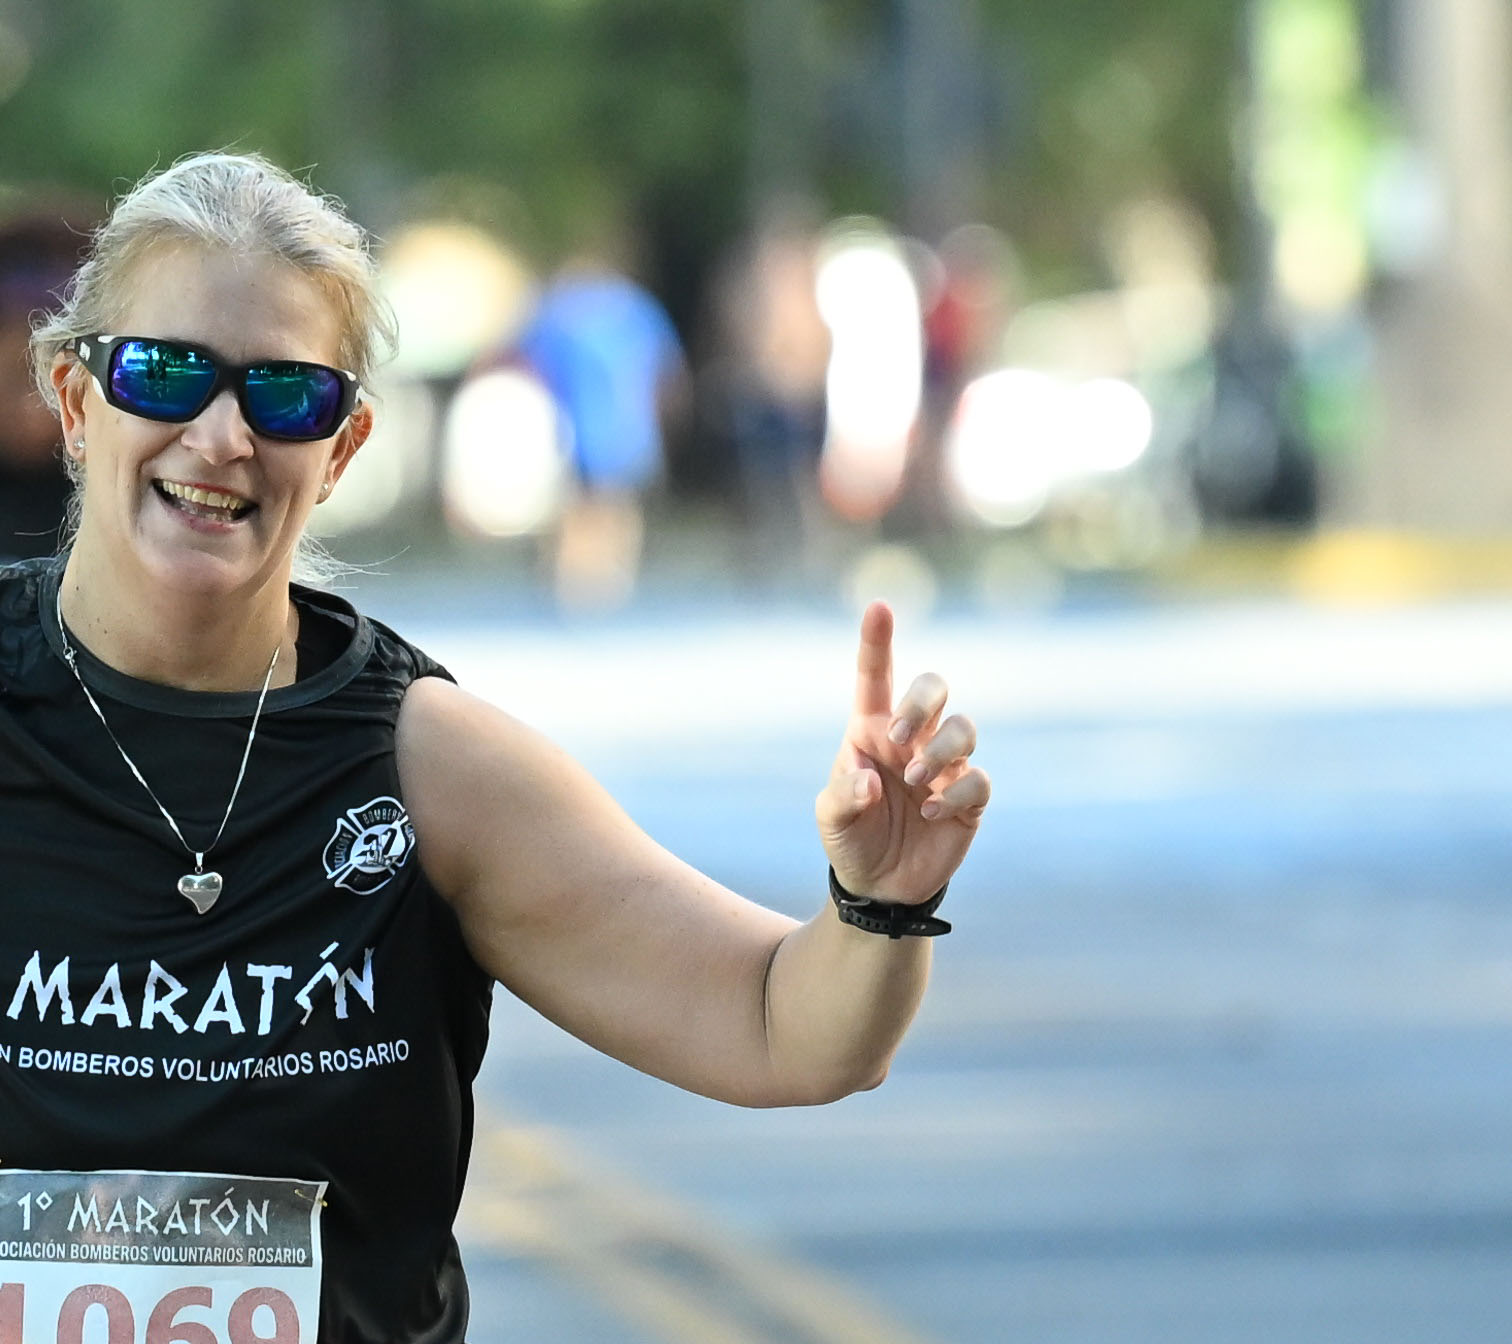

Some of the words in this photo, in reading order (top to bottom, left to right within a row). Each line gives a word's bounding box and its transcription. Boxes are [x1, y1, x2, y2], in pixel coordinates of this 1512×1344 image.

[6, 941, 375, 1035] MARATÓN
[18, 1047, 154, 1079] BOMBEROS
[163, 1053, 313, 1082] VOLUNTARIOS
[320, 1039, 410, 1073] ROSARIO
[67, 1187, 269, 1236] MARATÓN
[70, 1244, 148, 1262] BOMBEROS
[153, 1246, 243, 1264] VOLUNTARIOS
[248, 1247, 306, 1264] ROSARIO
